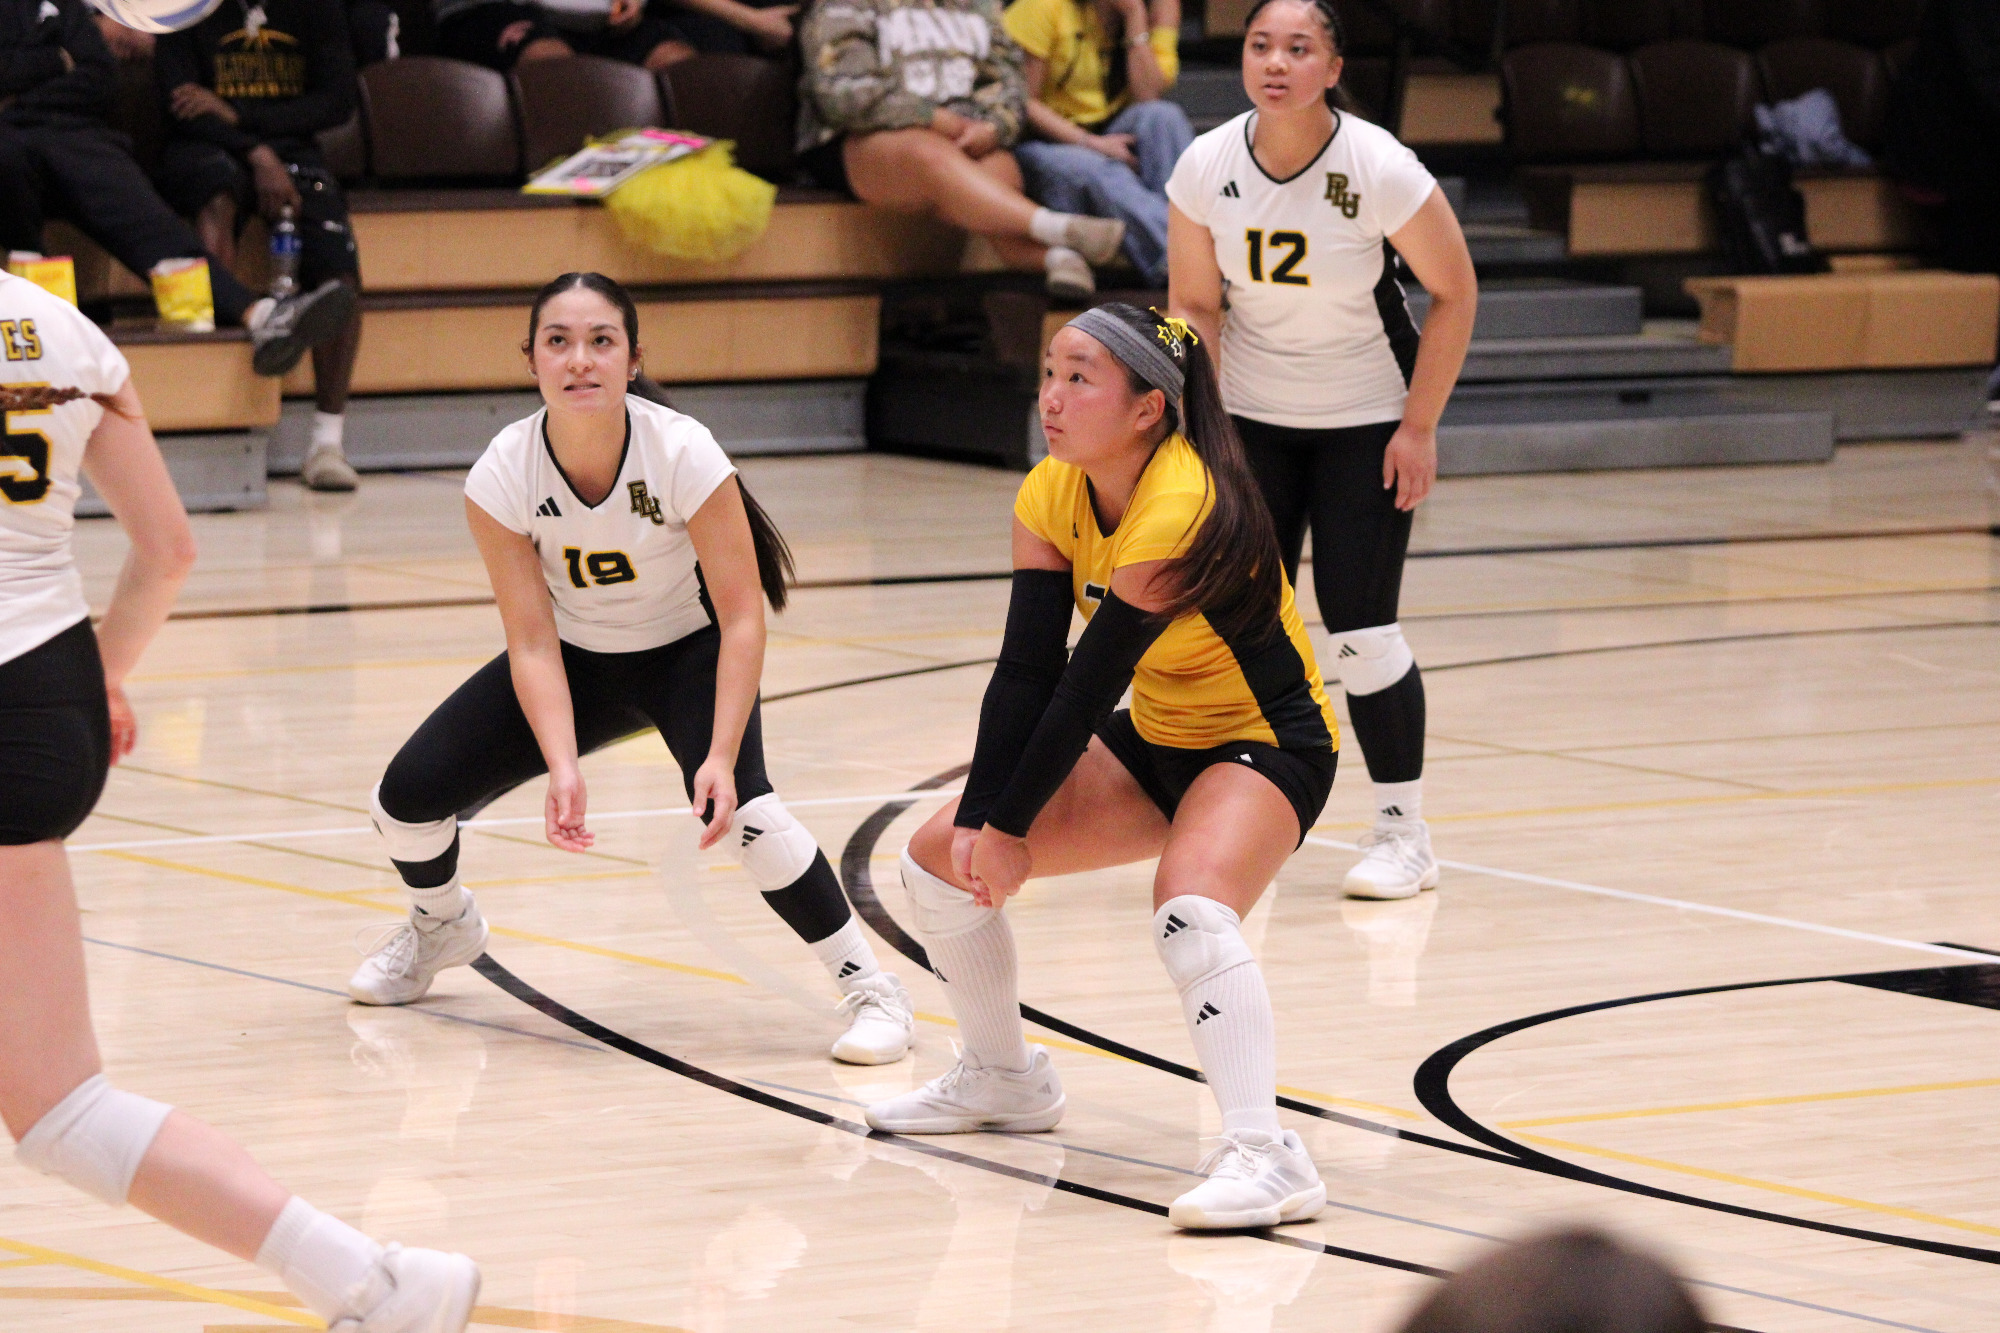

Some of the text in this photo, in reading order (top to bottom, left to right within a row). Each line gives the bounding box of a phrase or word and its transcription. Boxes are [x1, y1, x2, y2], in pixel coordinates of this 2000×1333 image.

[1324, 172, 1361, 219] PLU
[1245, 228, 1311, 286] 12
[562, 546, 638, 589] 19
